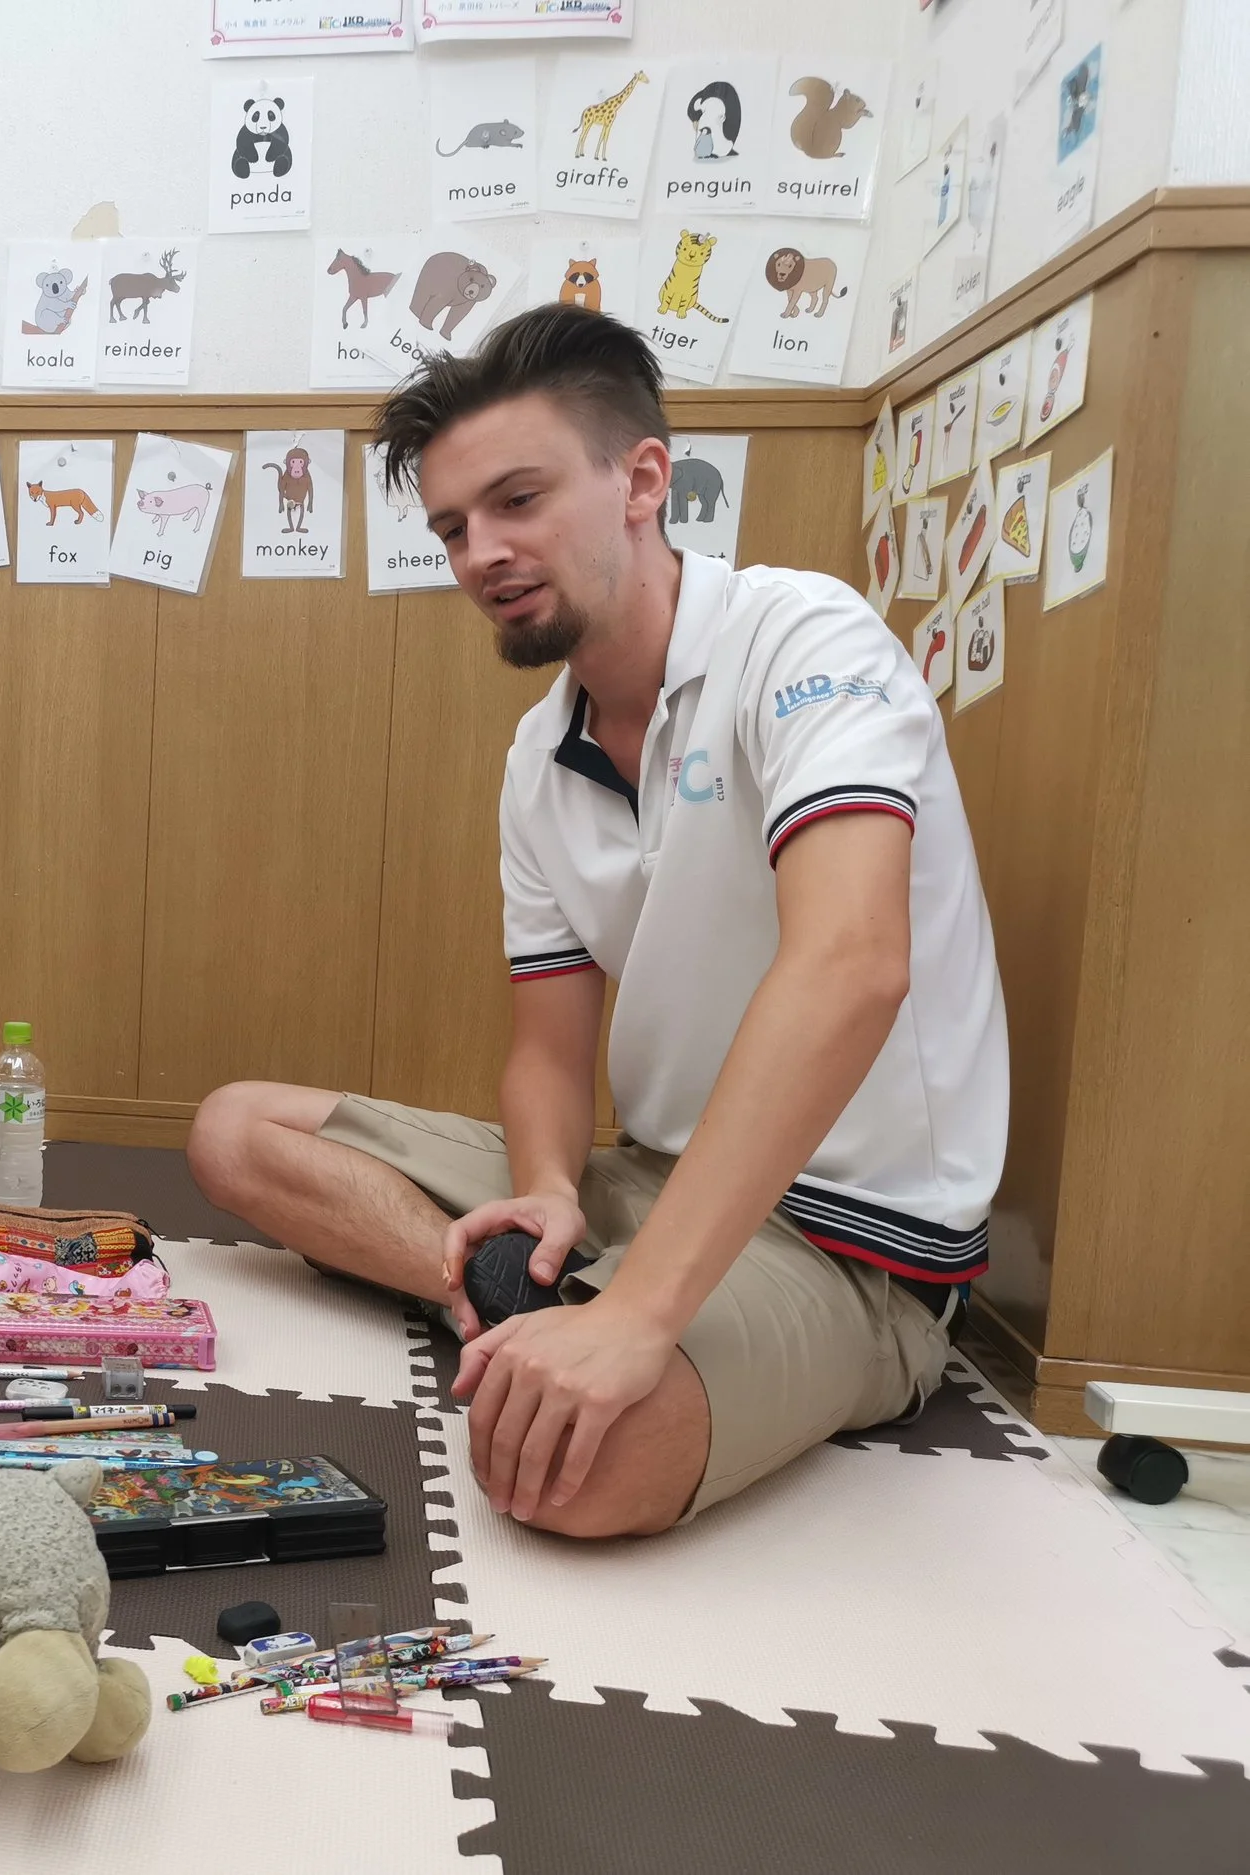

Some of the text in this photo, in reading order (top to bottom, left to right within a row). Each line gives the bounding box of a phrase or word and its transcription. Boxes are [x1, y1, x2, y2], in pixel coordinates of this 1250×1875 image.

[556, 167, 628, 188] giraffe
[667, 178, 750, 198] penguin
[231, 184, 291, 209] panda
[450, 183, 515, 200] mouse
[778, 178, 858, 199] squirrel
[1056, 172, 1085, 213] eagle
[105, 339, 181, 357] reindeer
[389, 327, 423, 361] bea
[651, 326, 699, 352] tiger
[773, 330, 808, 352] lion
[28, 349, 74, 367] koala
[49, 545, 76, 562] fox
[257, 538, 328, 560] monkey
[387, 549, 447, 568] sheep
[143, 550, 172, 570] pig
[715, 776, 725, 802] CLUB
[94, 1406, 126, 1414] マイネーム
